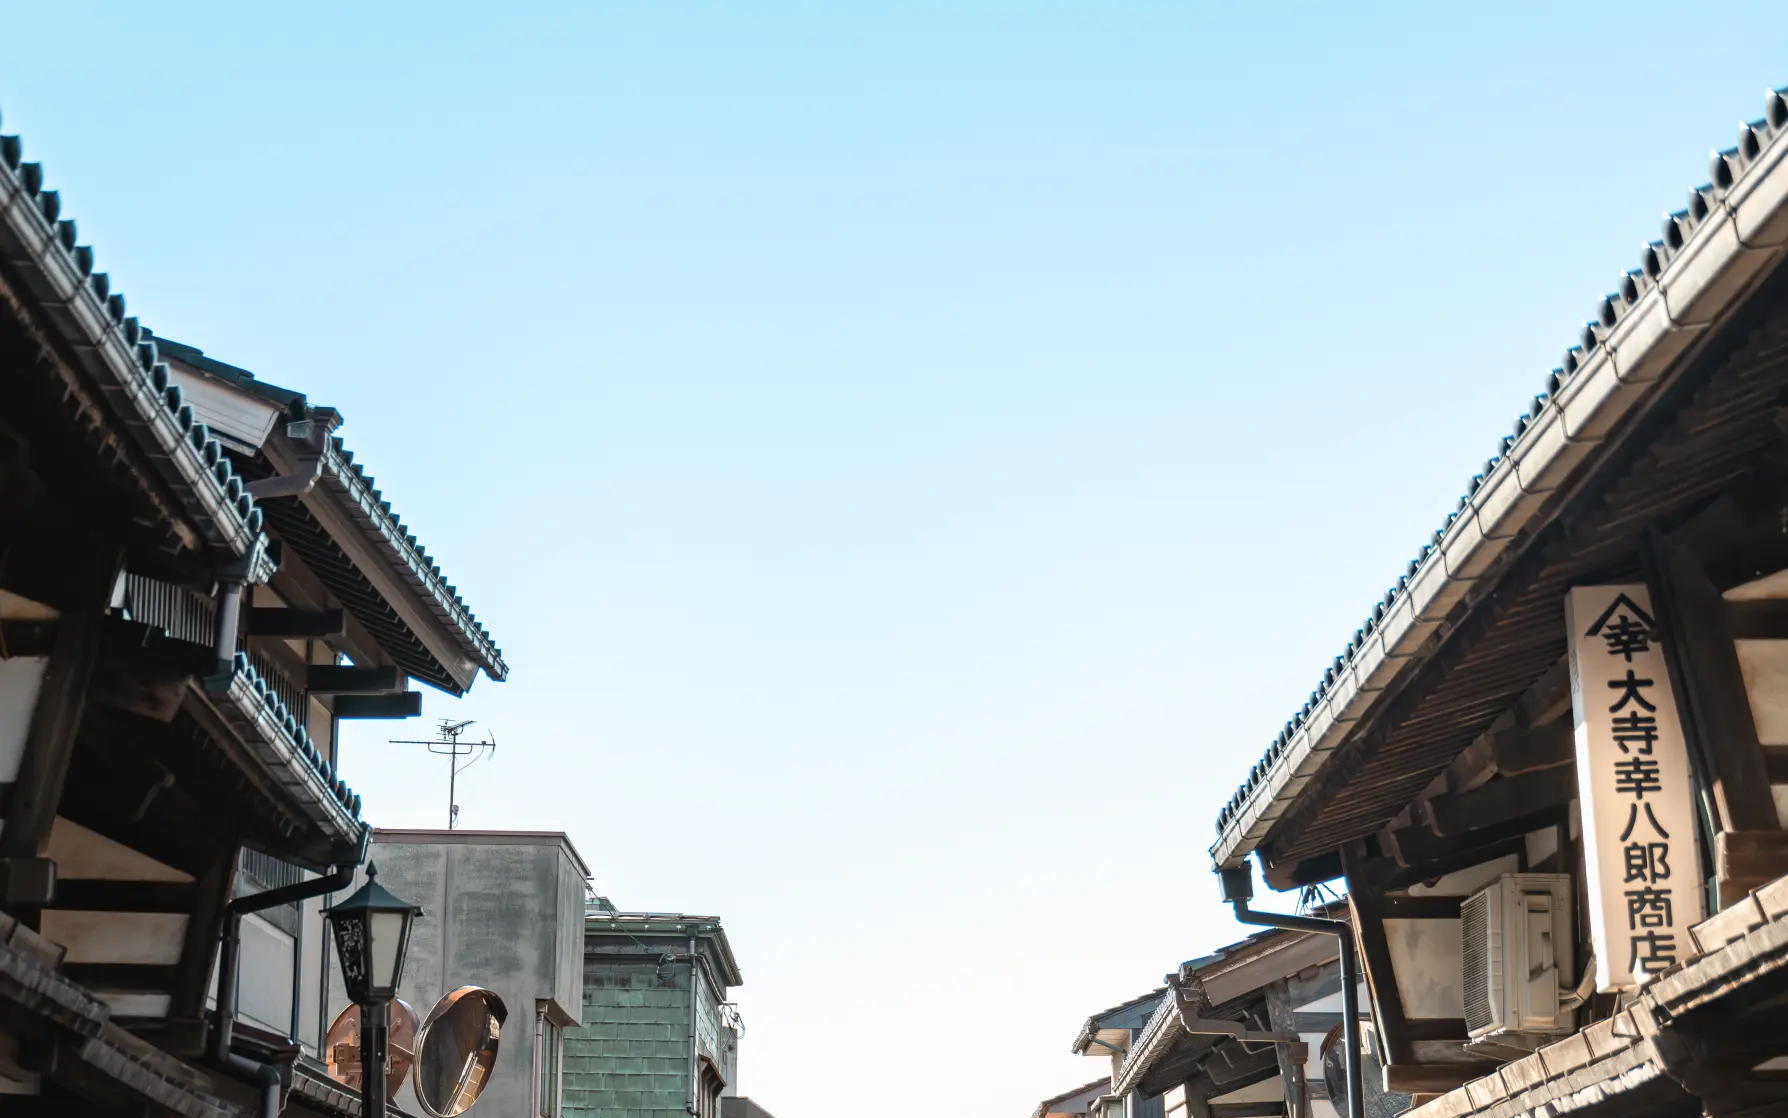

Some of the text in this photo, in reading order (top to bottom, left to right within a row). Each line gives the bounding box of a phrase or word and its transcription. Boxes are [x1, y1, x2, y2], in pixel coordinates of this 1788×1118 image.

[1607, 669, 1677, 976] 大寺幸八郎商店
